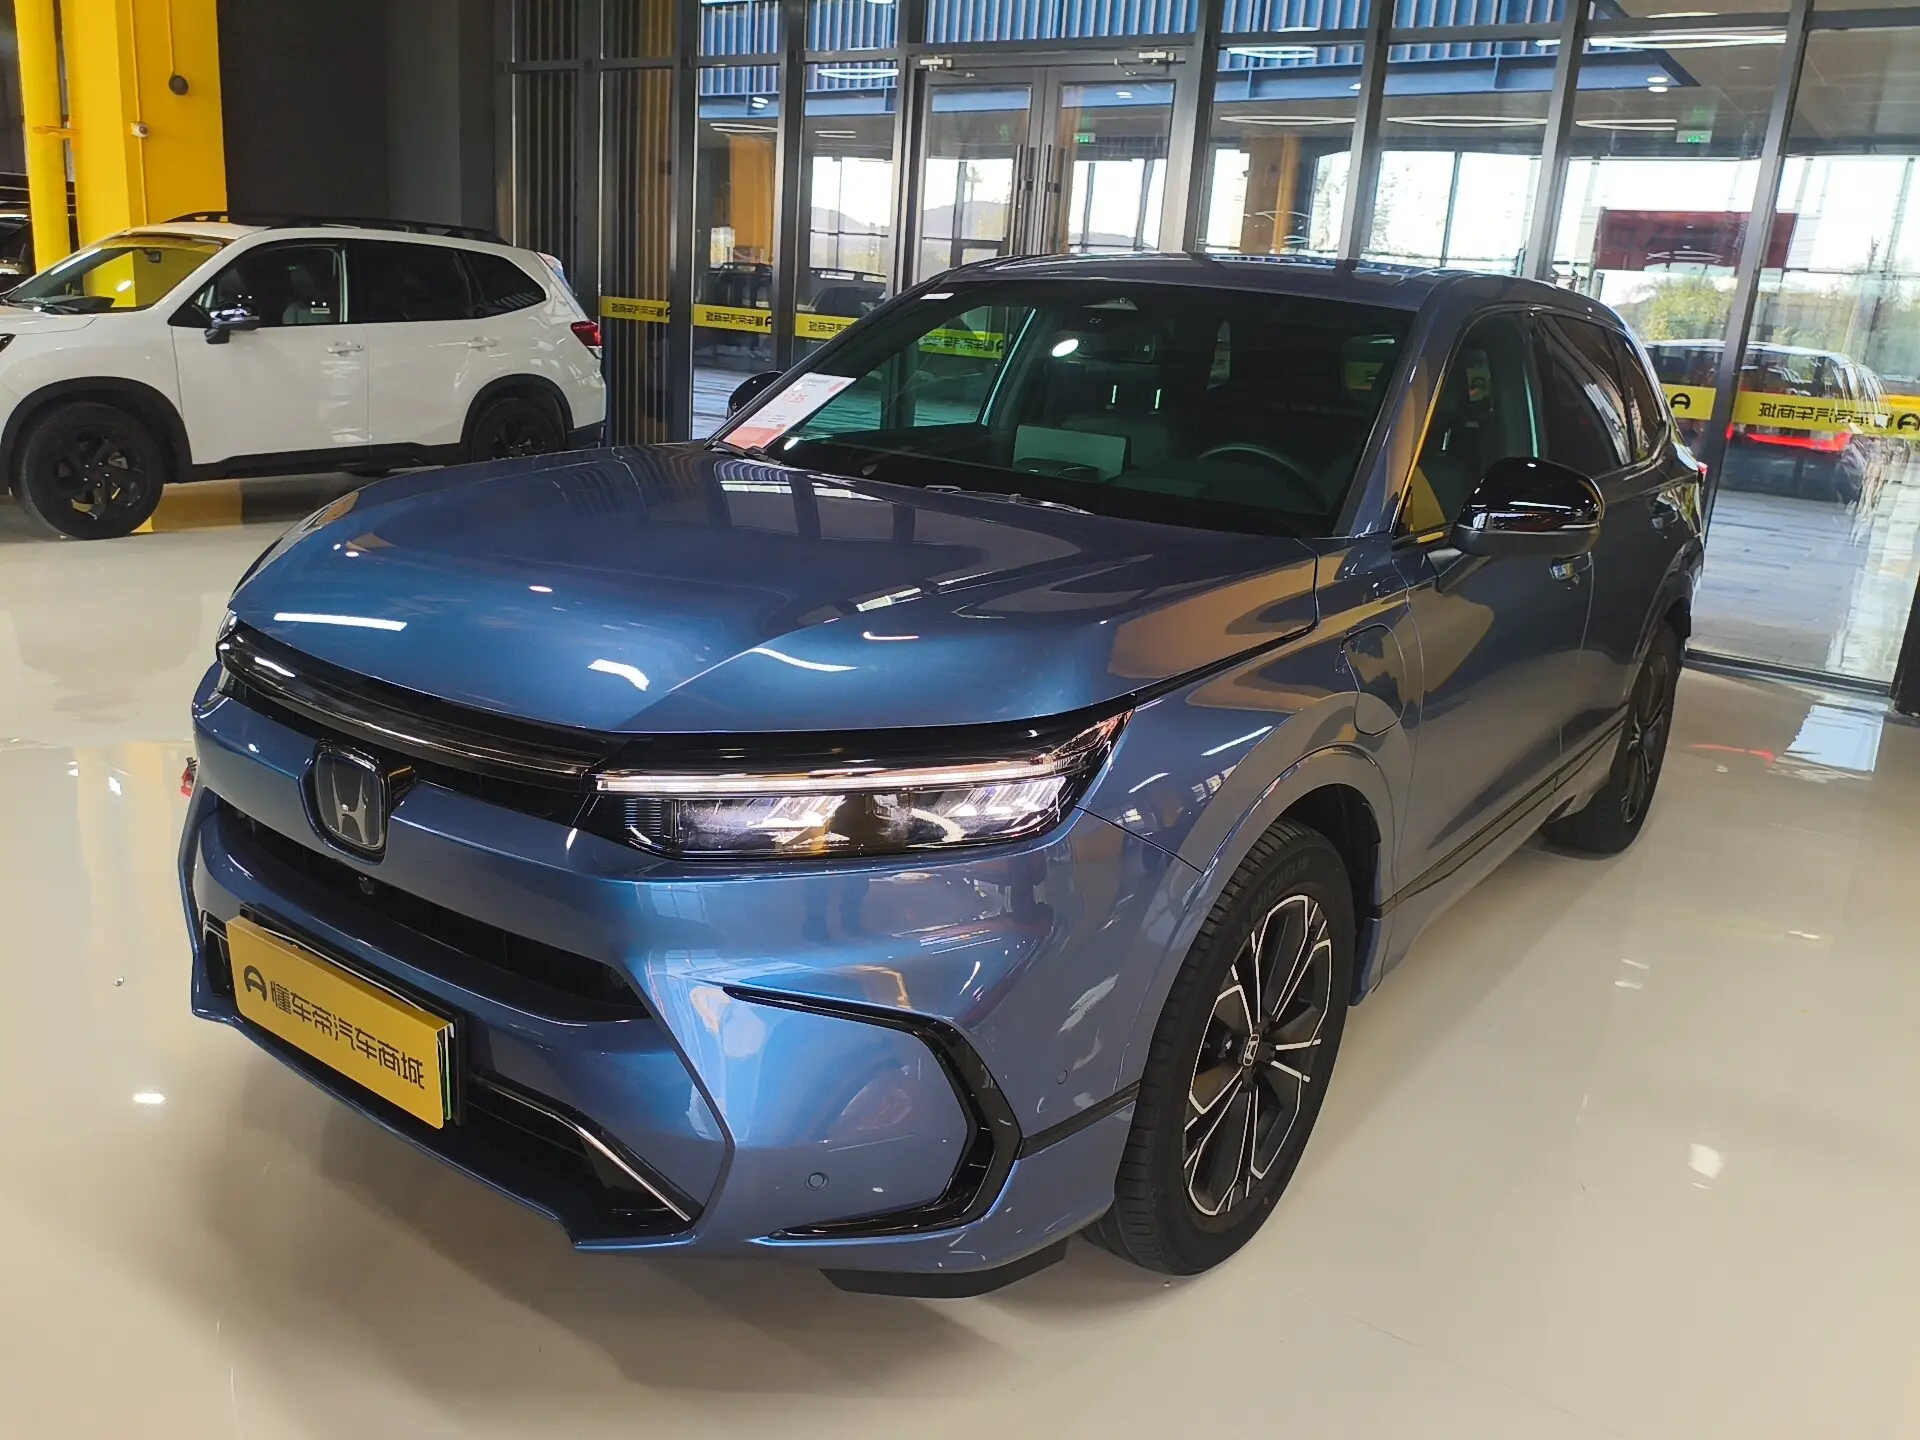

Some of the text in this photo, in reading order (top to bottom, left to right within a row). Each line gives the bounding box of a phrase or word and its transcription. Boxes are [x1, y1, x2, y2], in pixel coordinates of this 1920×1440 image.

[270, 980, 425, 1090] 懂车帝汽车商城
